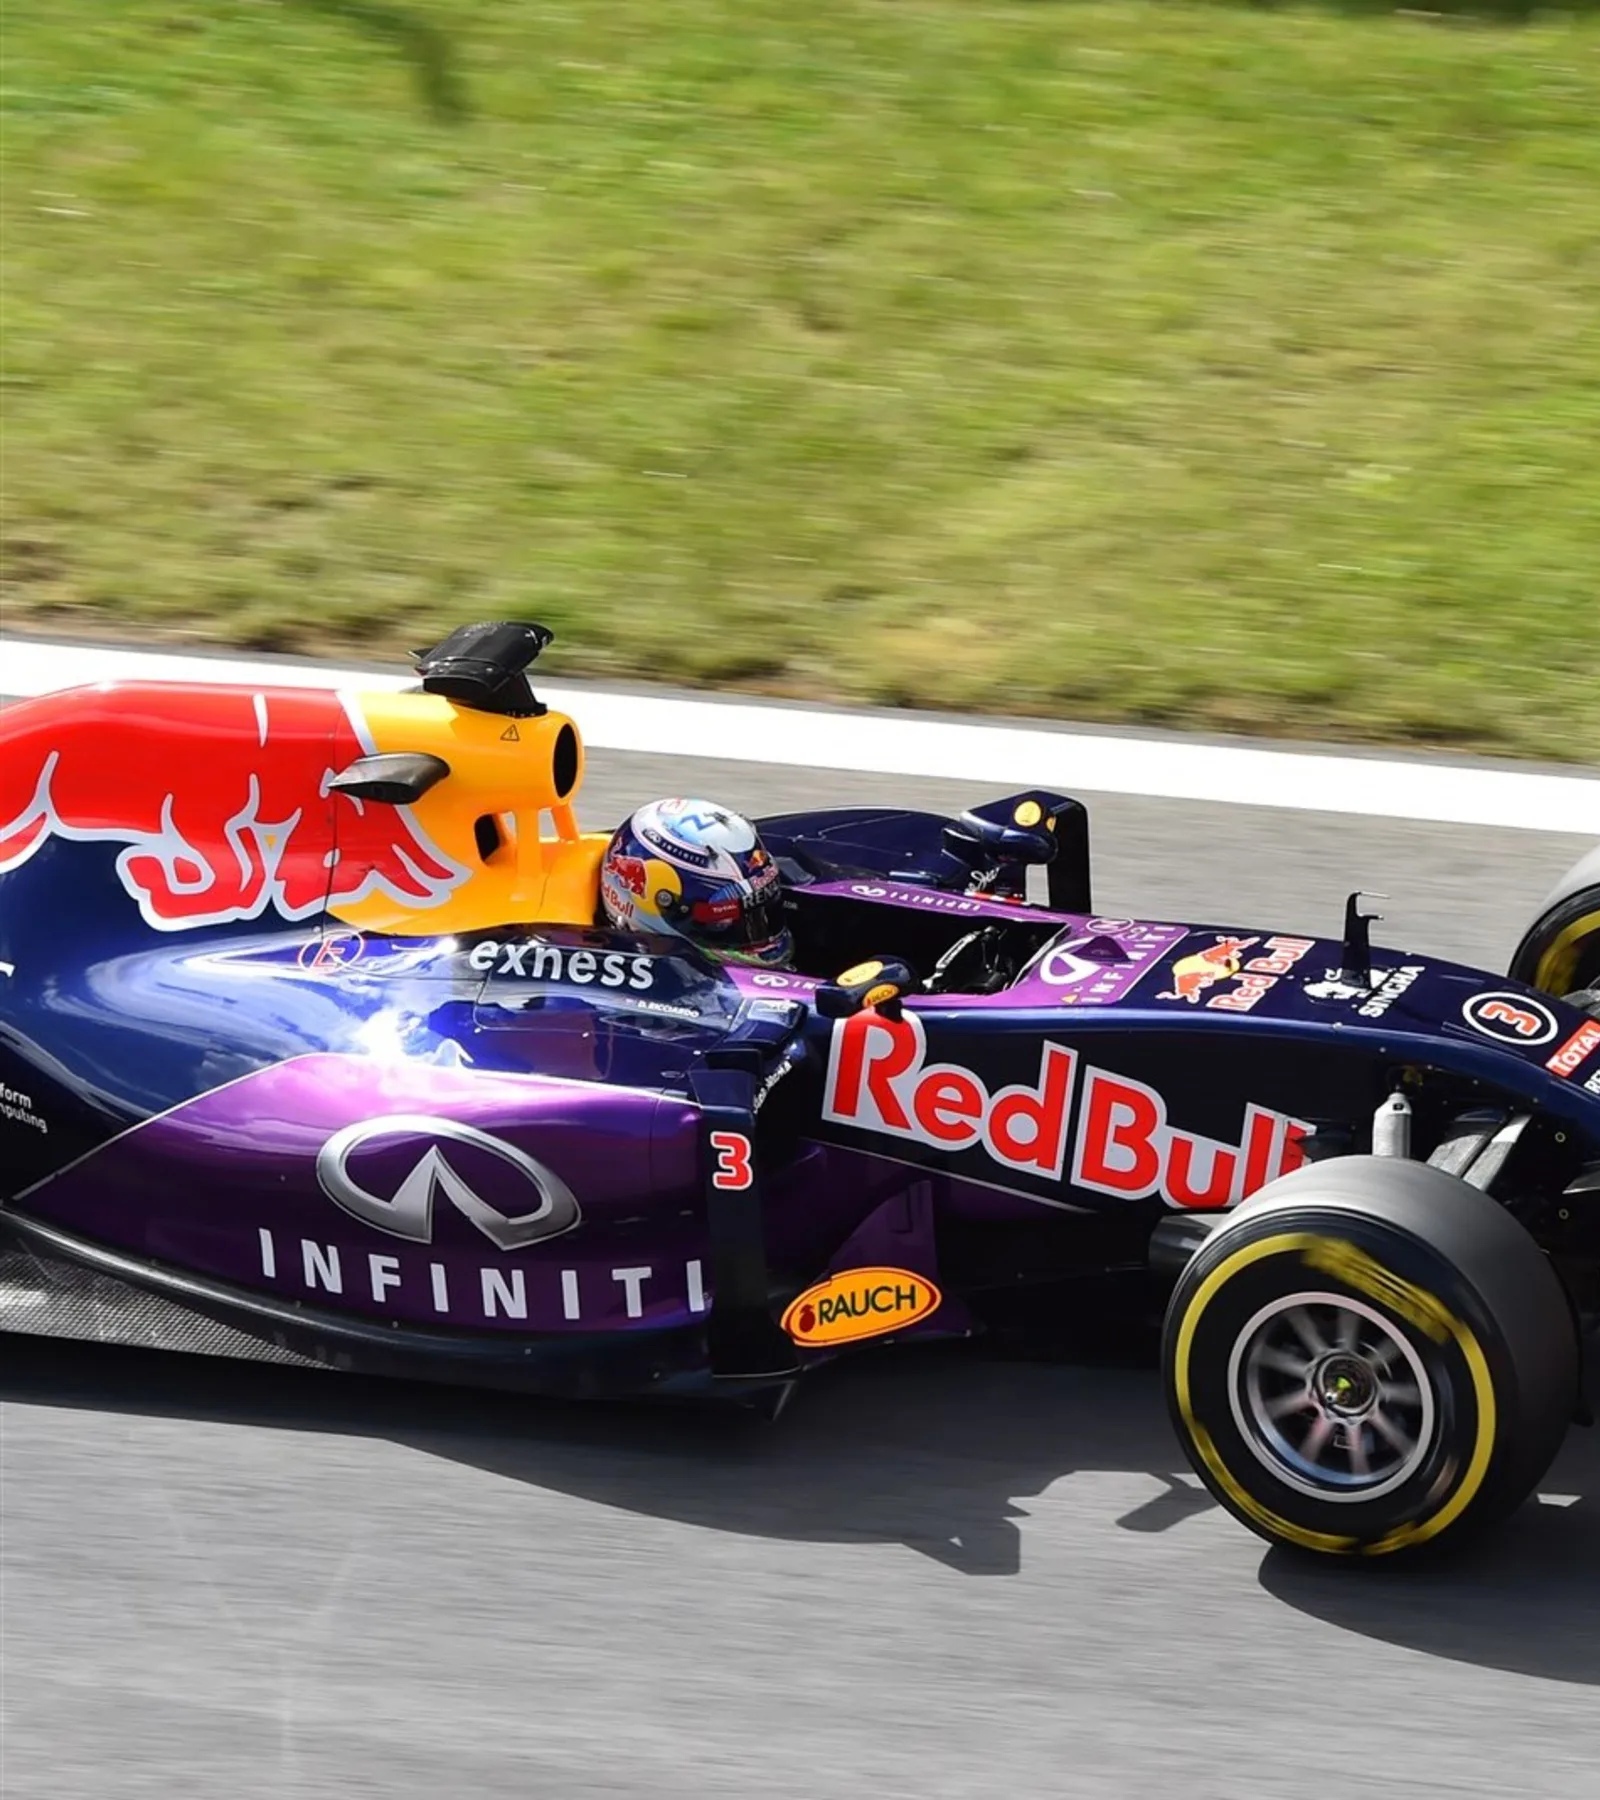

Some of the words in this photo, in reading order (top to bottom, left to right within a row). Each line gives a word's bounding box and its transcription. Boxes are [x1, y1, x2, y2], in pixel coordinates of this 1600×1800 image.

[468, 940, 655, 990] exness
[1206, 972, 1279, 1012] Red
[1244, 936, 1315, 975] Bull
[1358, 965, 1426, 1018] SINGHA
[1477, 1000, 1542, 1036] 3
[822, 1008, 1077, 1181] Red
[710, 1131, 754, 1190] 3
[258, 1228, 705, 1320] INFINITI
[818, 1284, 916, 1326] RAUCH
